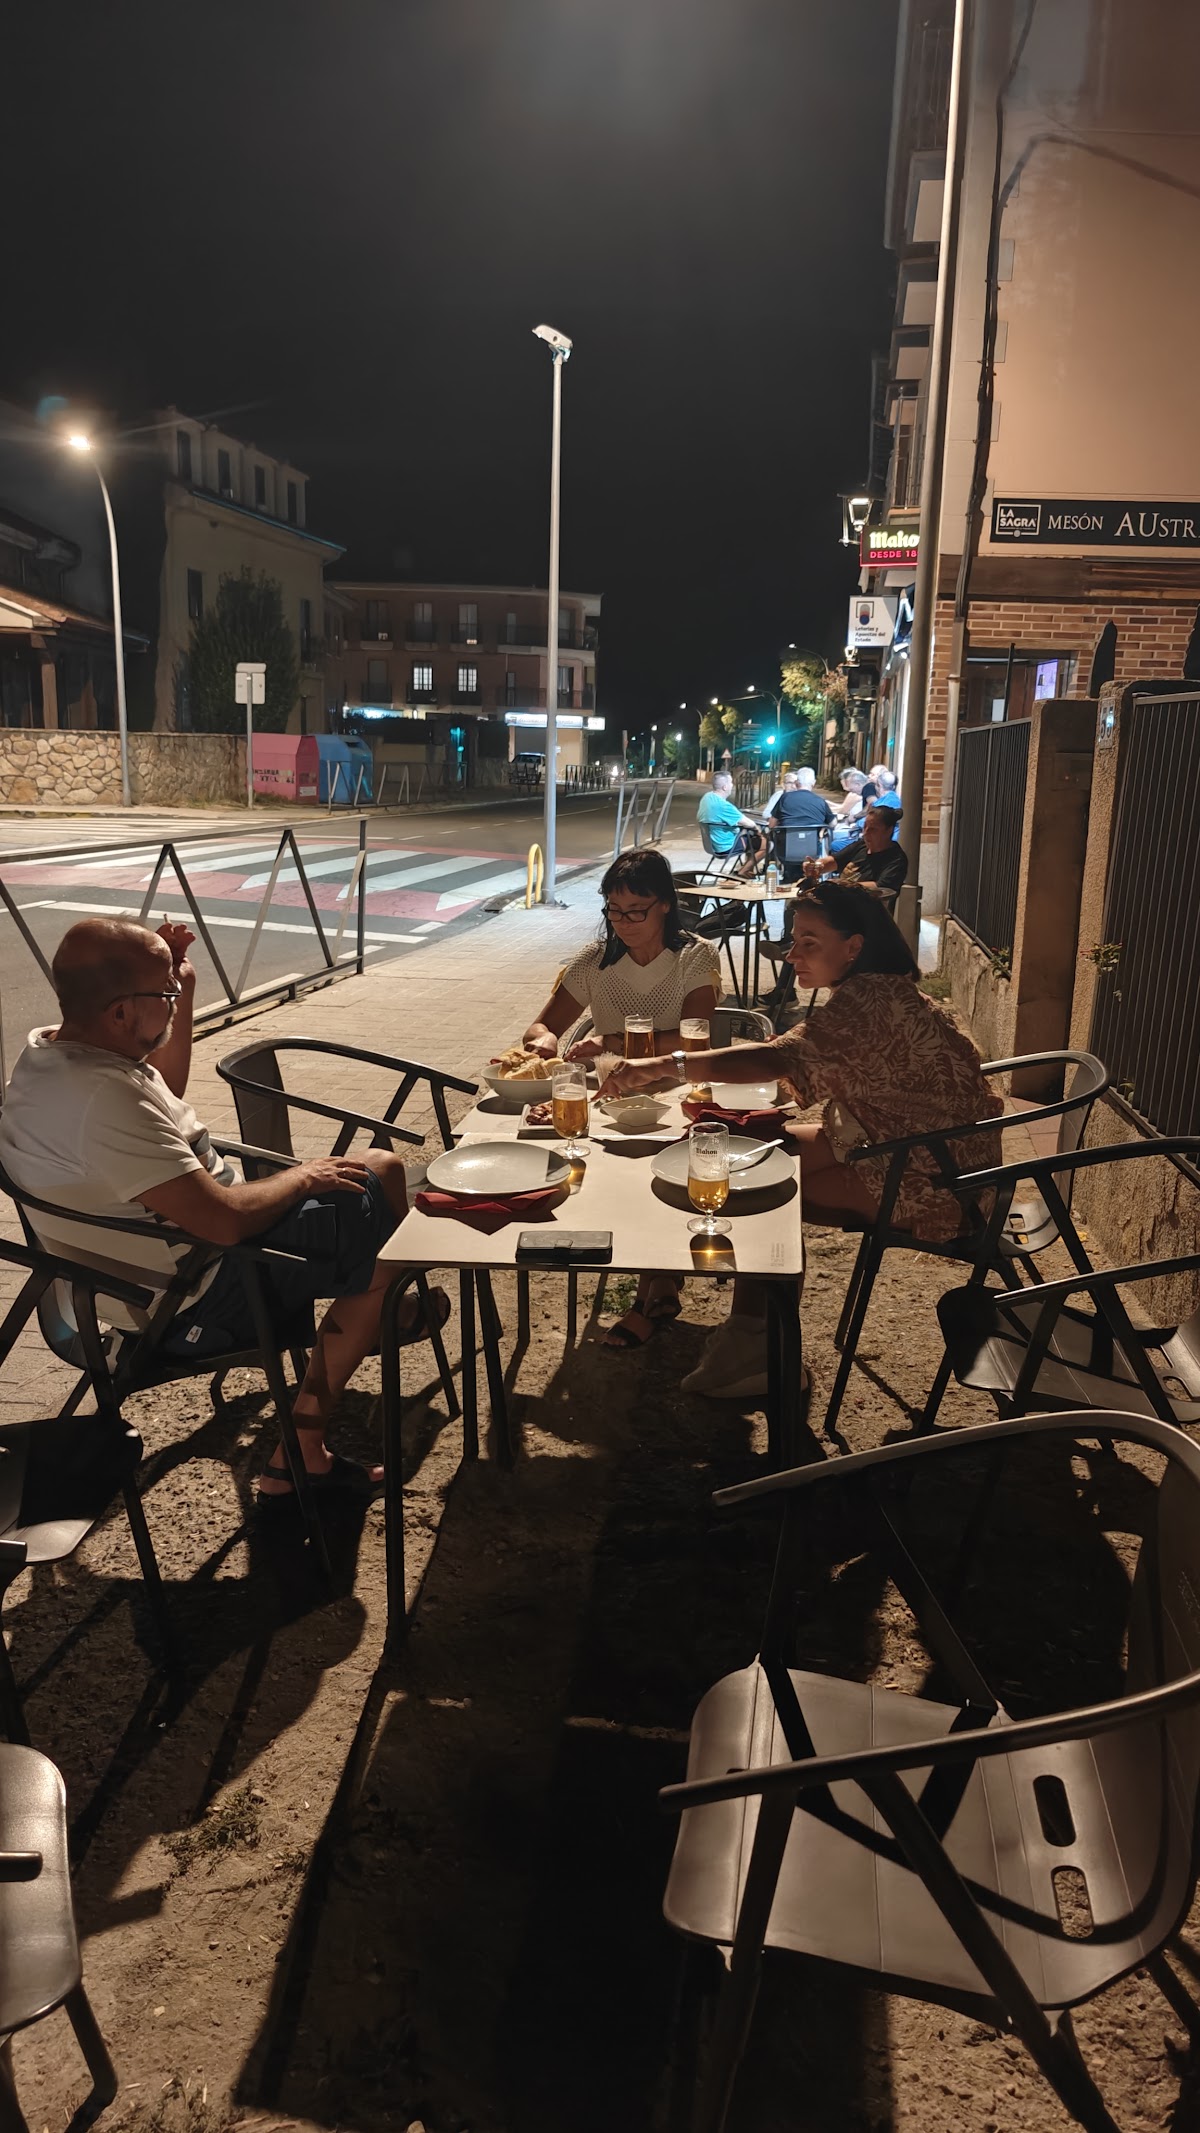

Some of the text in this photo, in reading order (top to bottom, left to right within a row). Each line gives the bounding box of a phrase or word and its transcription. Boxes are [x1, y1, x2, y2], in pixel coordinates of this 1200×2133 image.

[1000, 508, 1014, 518] LA
[1000, 518, 1036, 527] SAGRA
[1047, 511, 1200, 539] MESÓN AUSTR
[869, 530, 920, 548] Maho
[869, 550, 919, 559] DESDE 18
